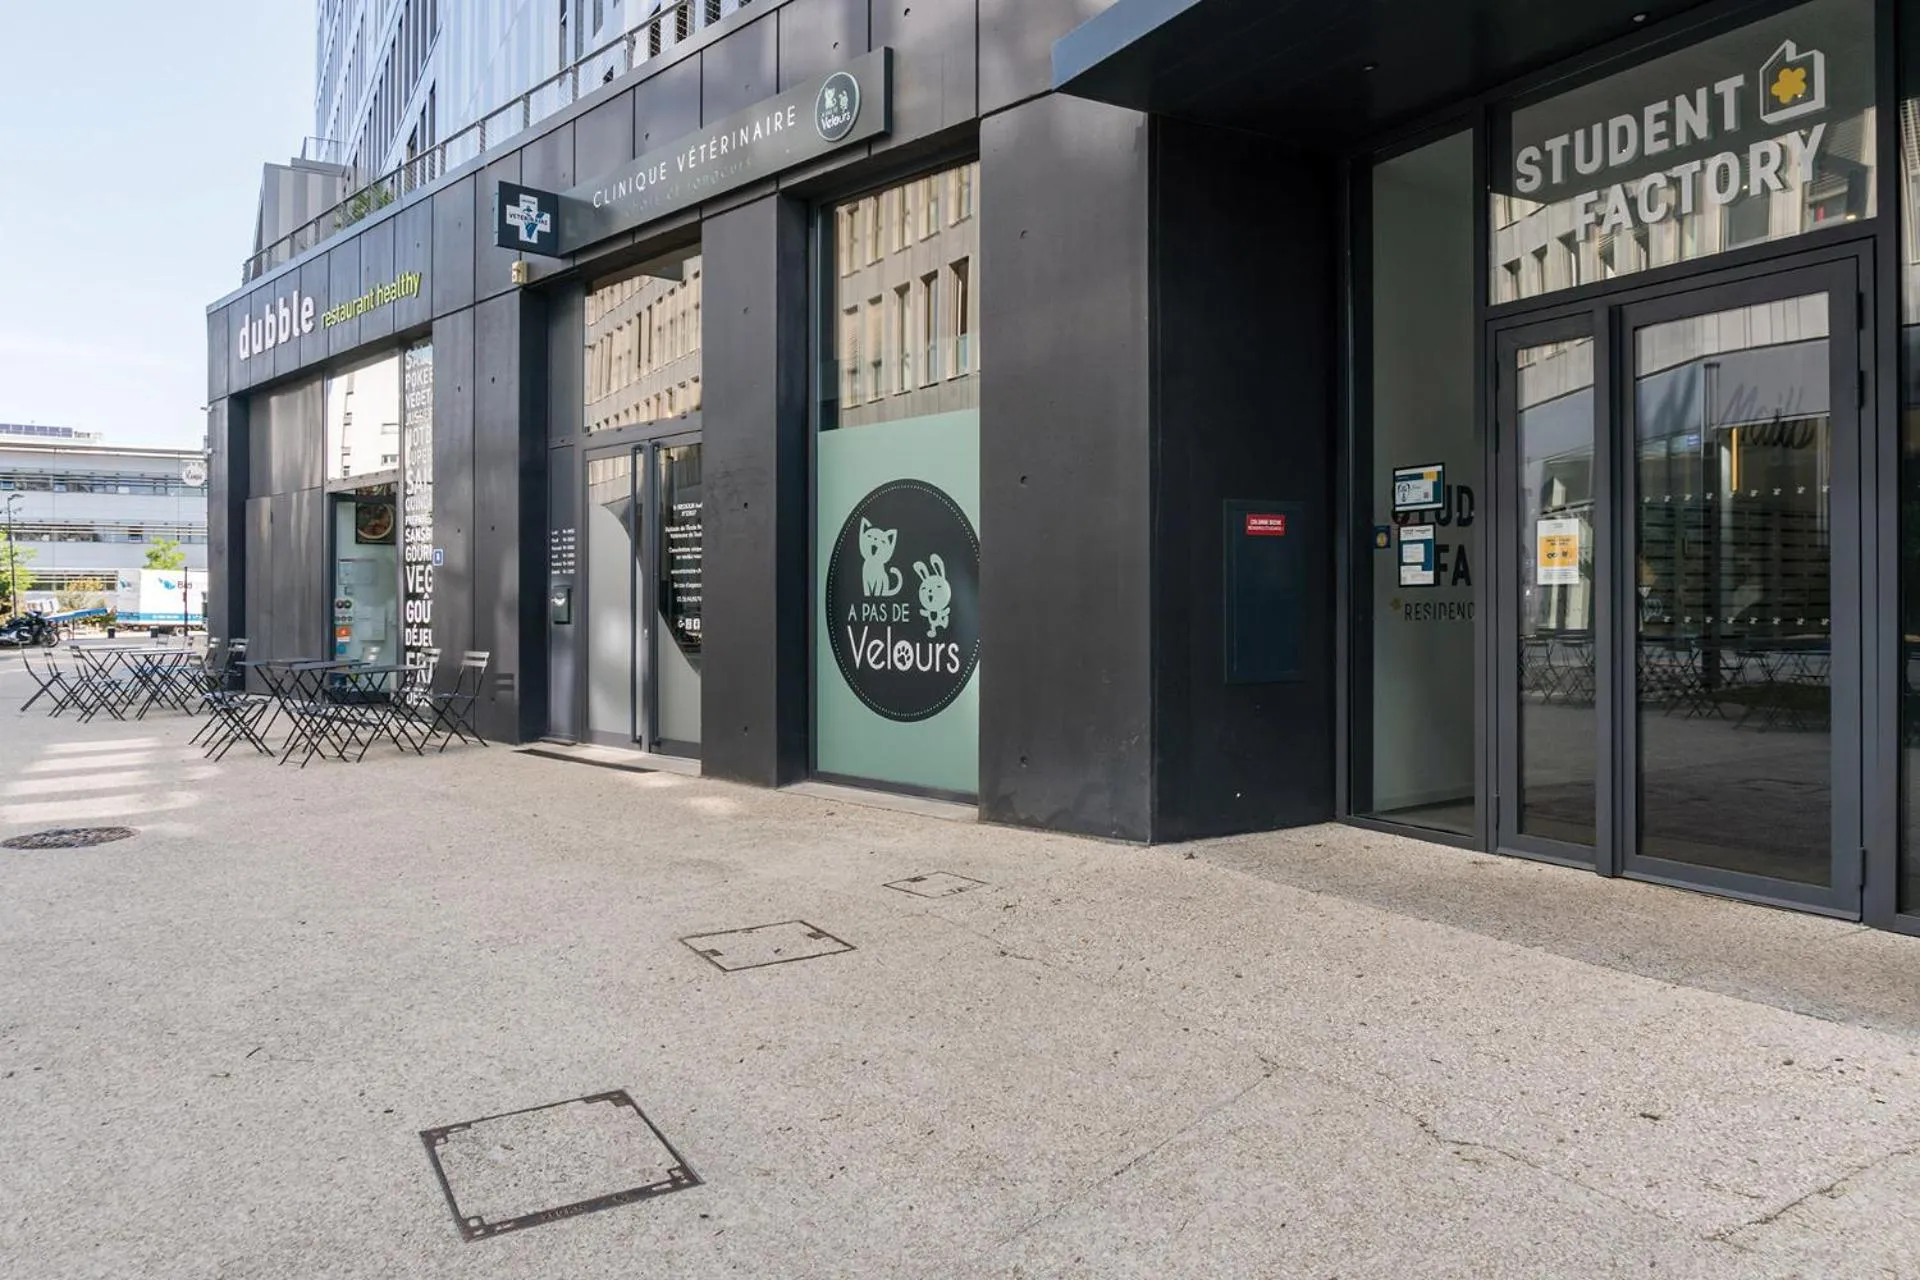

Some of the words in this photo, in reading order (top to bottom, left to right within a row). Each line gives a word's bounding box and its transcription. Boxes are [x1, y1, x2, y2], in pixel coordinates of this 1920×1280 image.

[592, 160, 668, 208] CLINIQUE
[676, 104, 797, 172] VÉTÉRINAIRE
[1516, 73, 1745, 193] STUDENT
[1572, 122, 1827, 242] FACTORY
[239, 290, 315, 360] dubble
[321, 288, 376, 329] restaurant
[376, 271, 421, 307] healthy
[406, 593, 432, 624] GOÛ
[848, 603, 858, 621] A
[862, 603, 888, 622] PAS
[892, 603, 911, 623] DE
[847, 625, 961, 674] Velours
